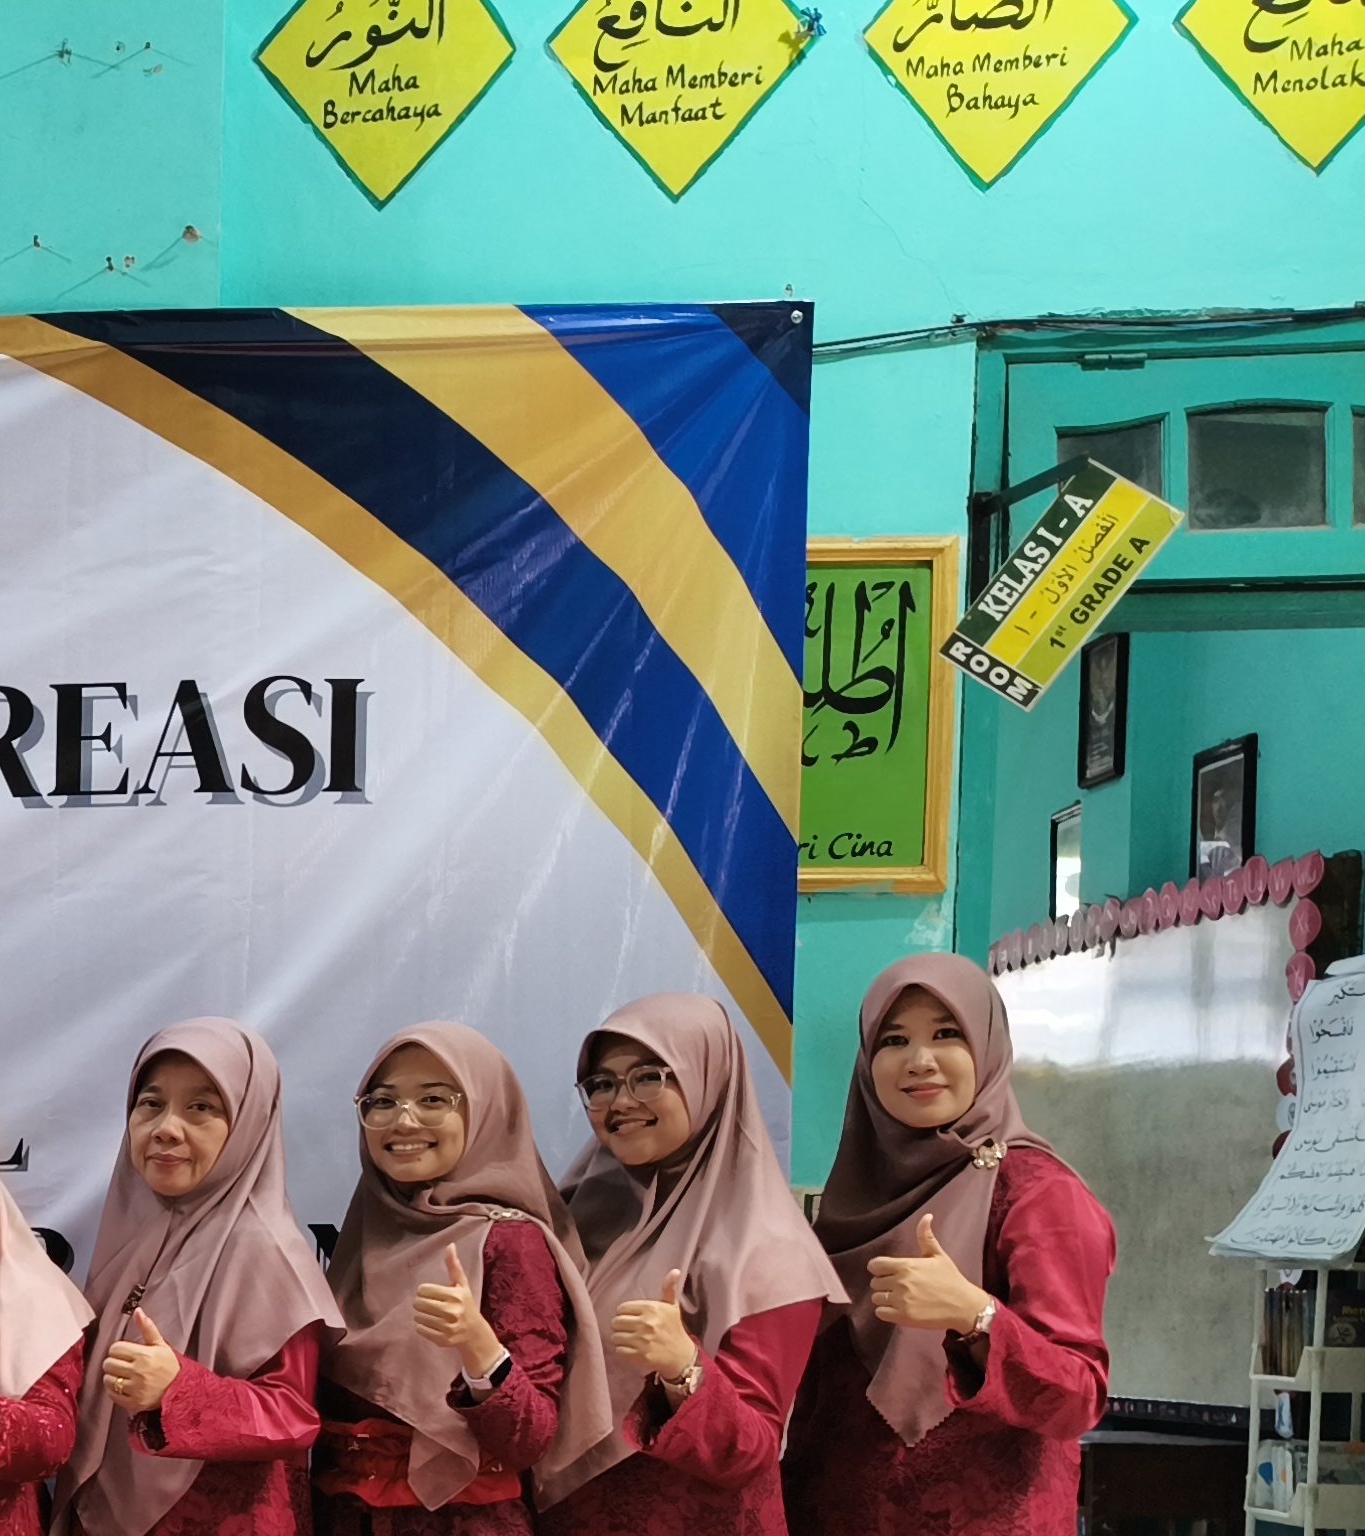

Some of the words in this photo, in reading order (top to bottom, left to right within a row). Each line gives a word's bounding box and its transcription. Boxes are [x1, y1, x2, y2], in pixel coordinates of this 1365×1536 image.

[905, 55, 964, 79] Maha
[971, 44, 1069, 74] Memberi
[1290, 32, 1365, 62] Maha
[348, 63, 420, 97] Maha
[592, 66, 658, 96] Maha
[666, 60, 766, 89] Memberi
[1253, 58, 1365, 95] Menolak
[322, 96, 442, 132] Bercahaya
[620, 94, 727, 127] Manfaat
[945, 82, 1040, 120] Bahaya
[977, 541, 1052, 622] KELAS
[1063, 493, 1094, 518] A
[1049, 624, 1068, 650] 1st
[1069, 553, 1134, 625] GRADE
[1129, 537, 1151, 555] A
[949, 641, 1033, 701] ROOM
[828, 832, 894, 860] Cina
